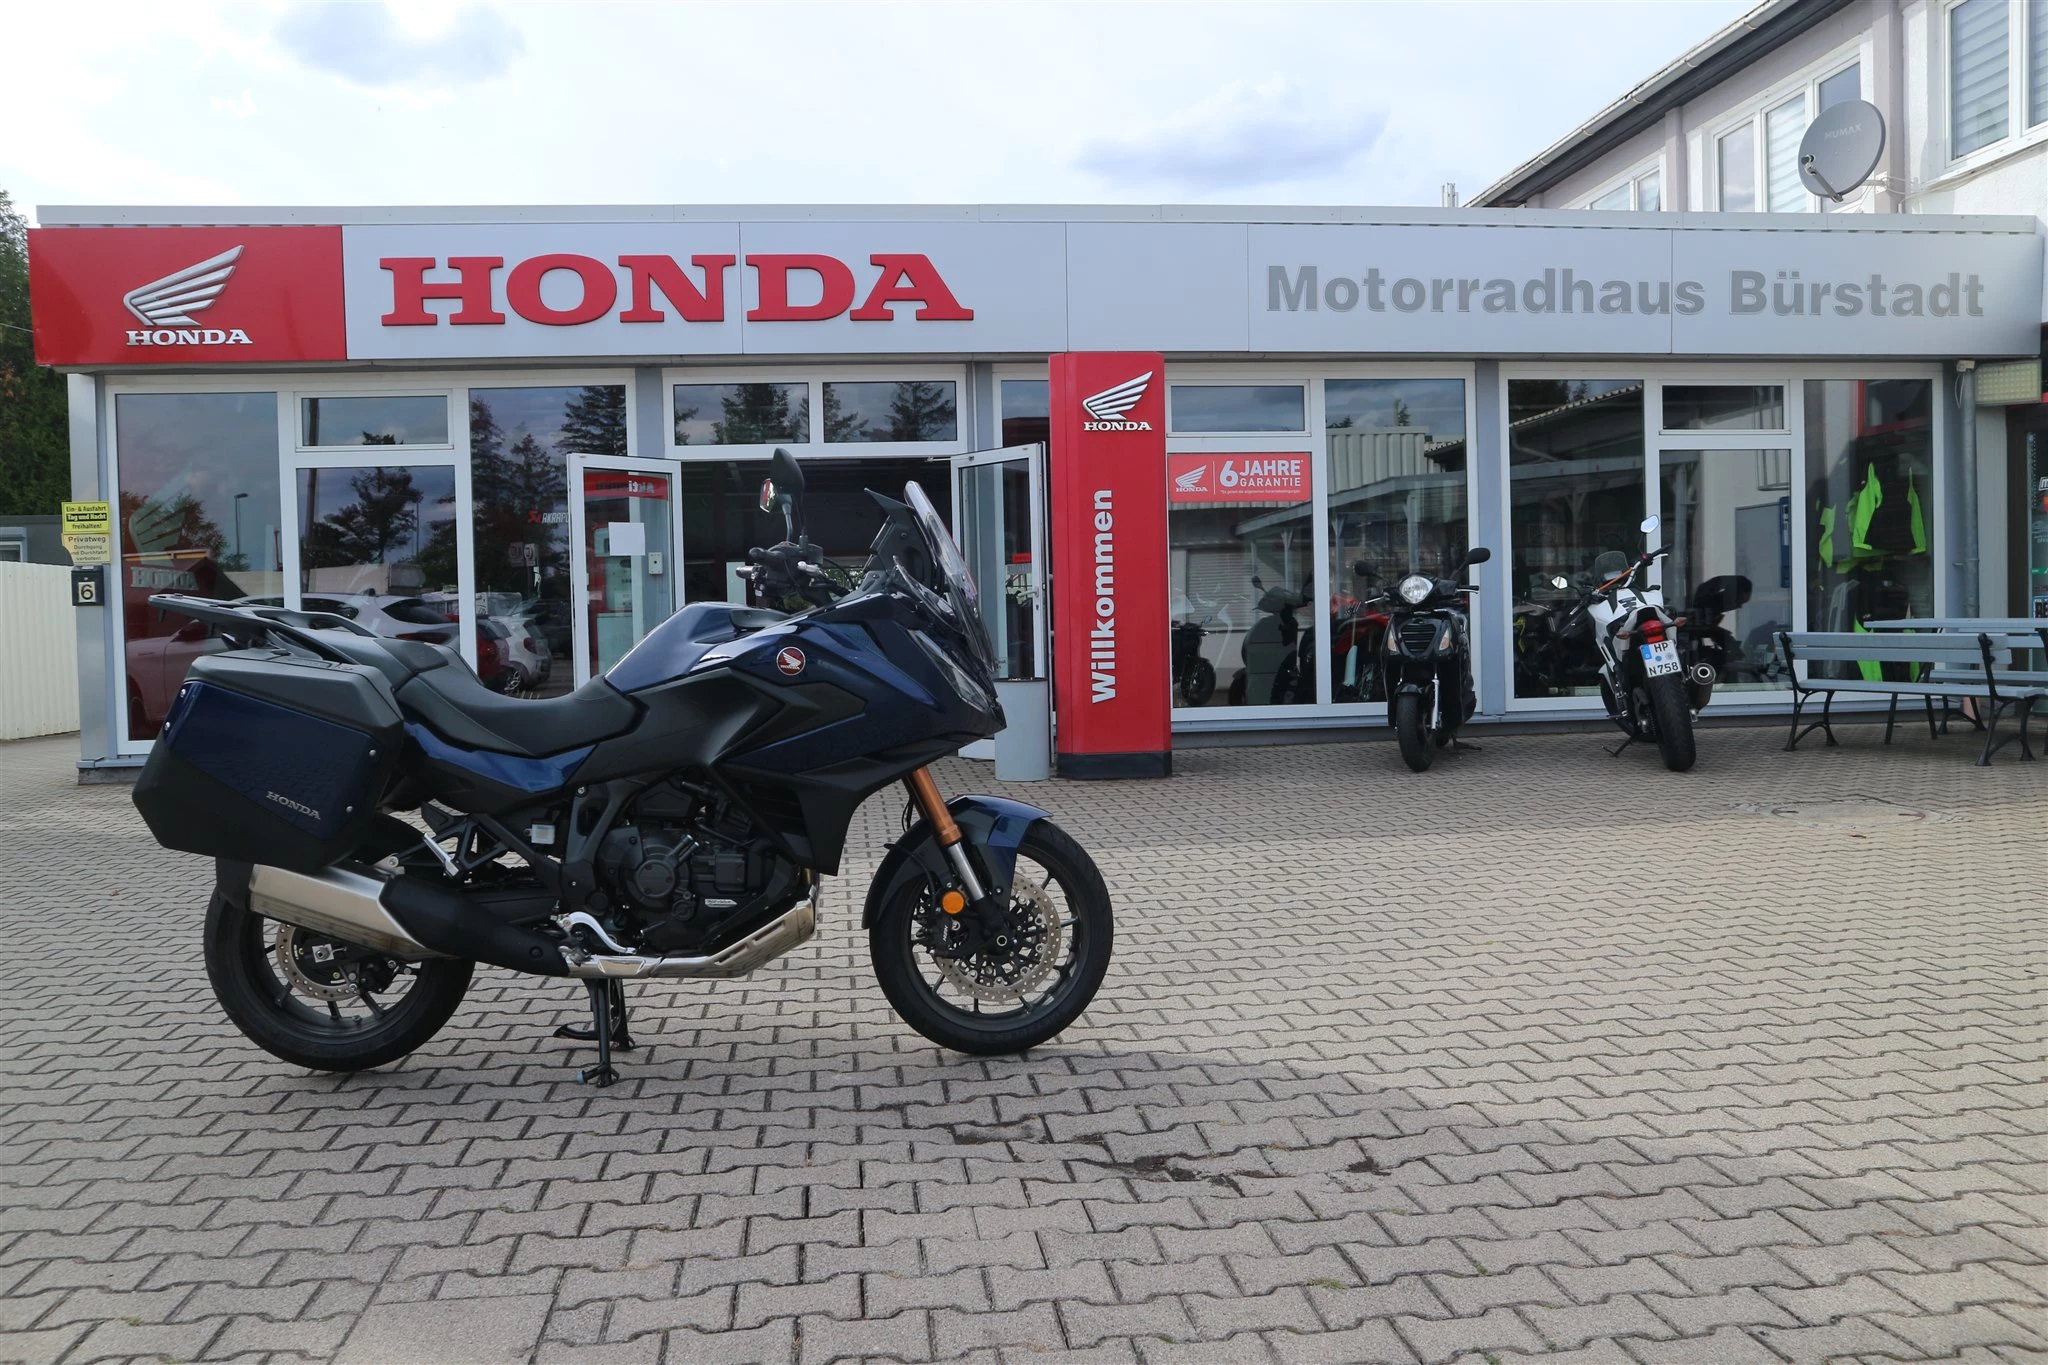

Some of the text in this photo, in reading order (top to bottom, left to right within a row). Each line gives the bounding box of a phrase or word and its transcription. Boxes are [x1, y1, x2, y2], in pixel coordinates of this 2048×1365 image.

[379, 253, 975, 326] HONDA
[1267, 264, 1986, 317] Motorradhaus Bürstadt
[125, 329, 253, 346] HONDA
[1083, 421, 1153, 431] HONDA
[1219, 460, 1239, 488] 6
[1240, 477, 1301, 487] GARANTIE
[81, 585, 94, 600] 6
[1091, 489, 1116, 704] Willkommen
[1654, 643, 1668, 652] HP
[266, 790, 321, 820] HONDA
